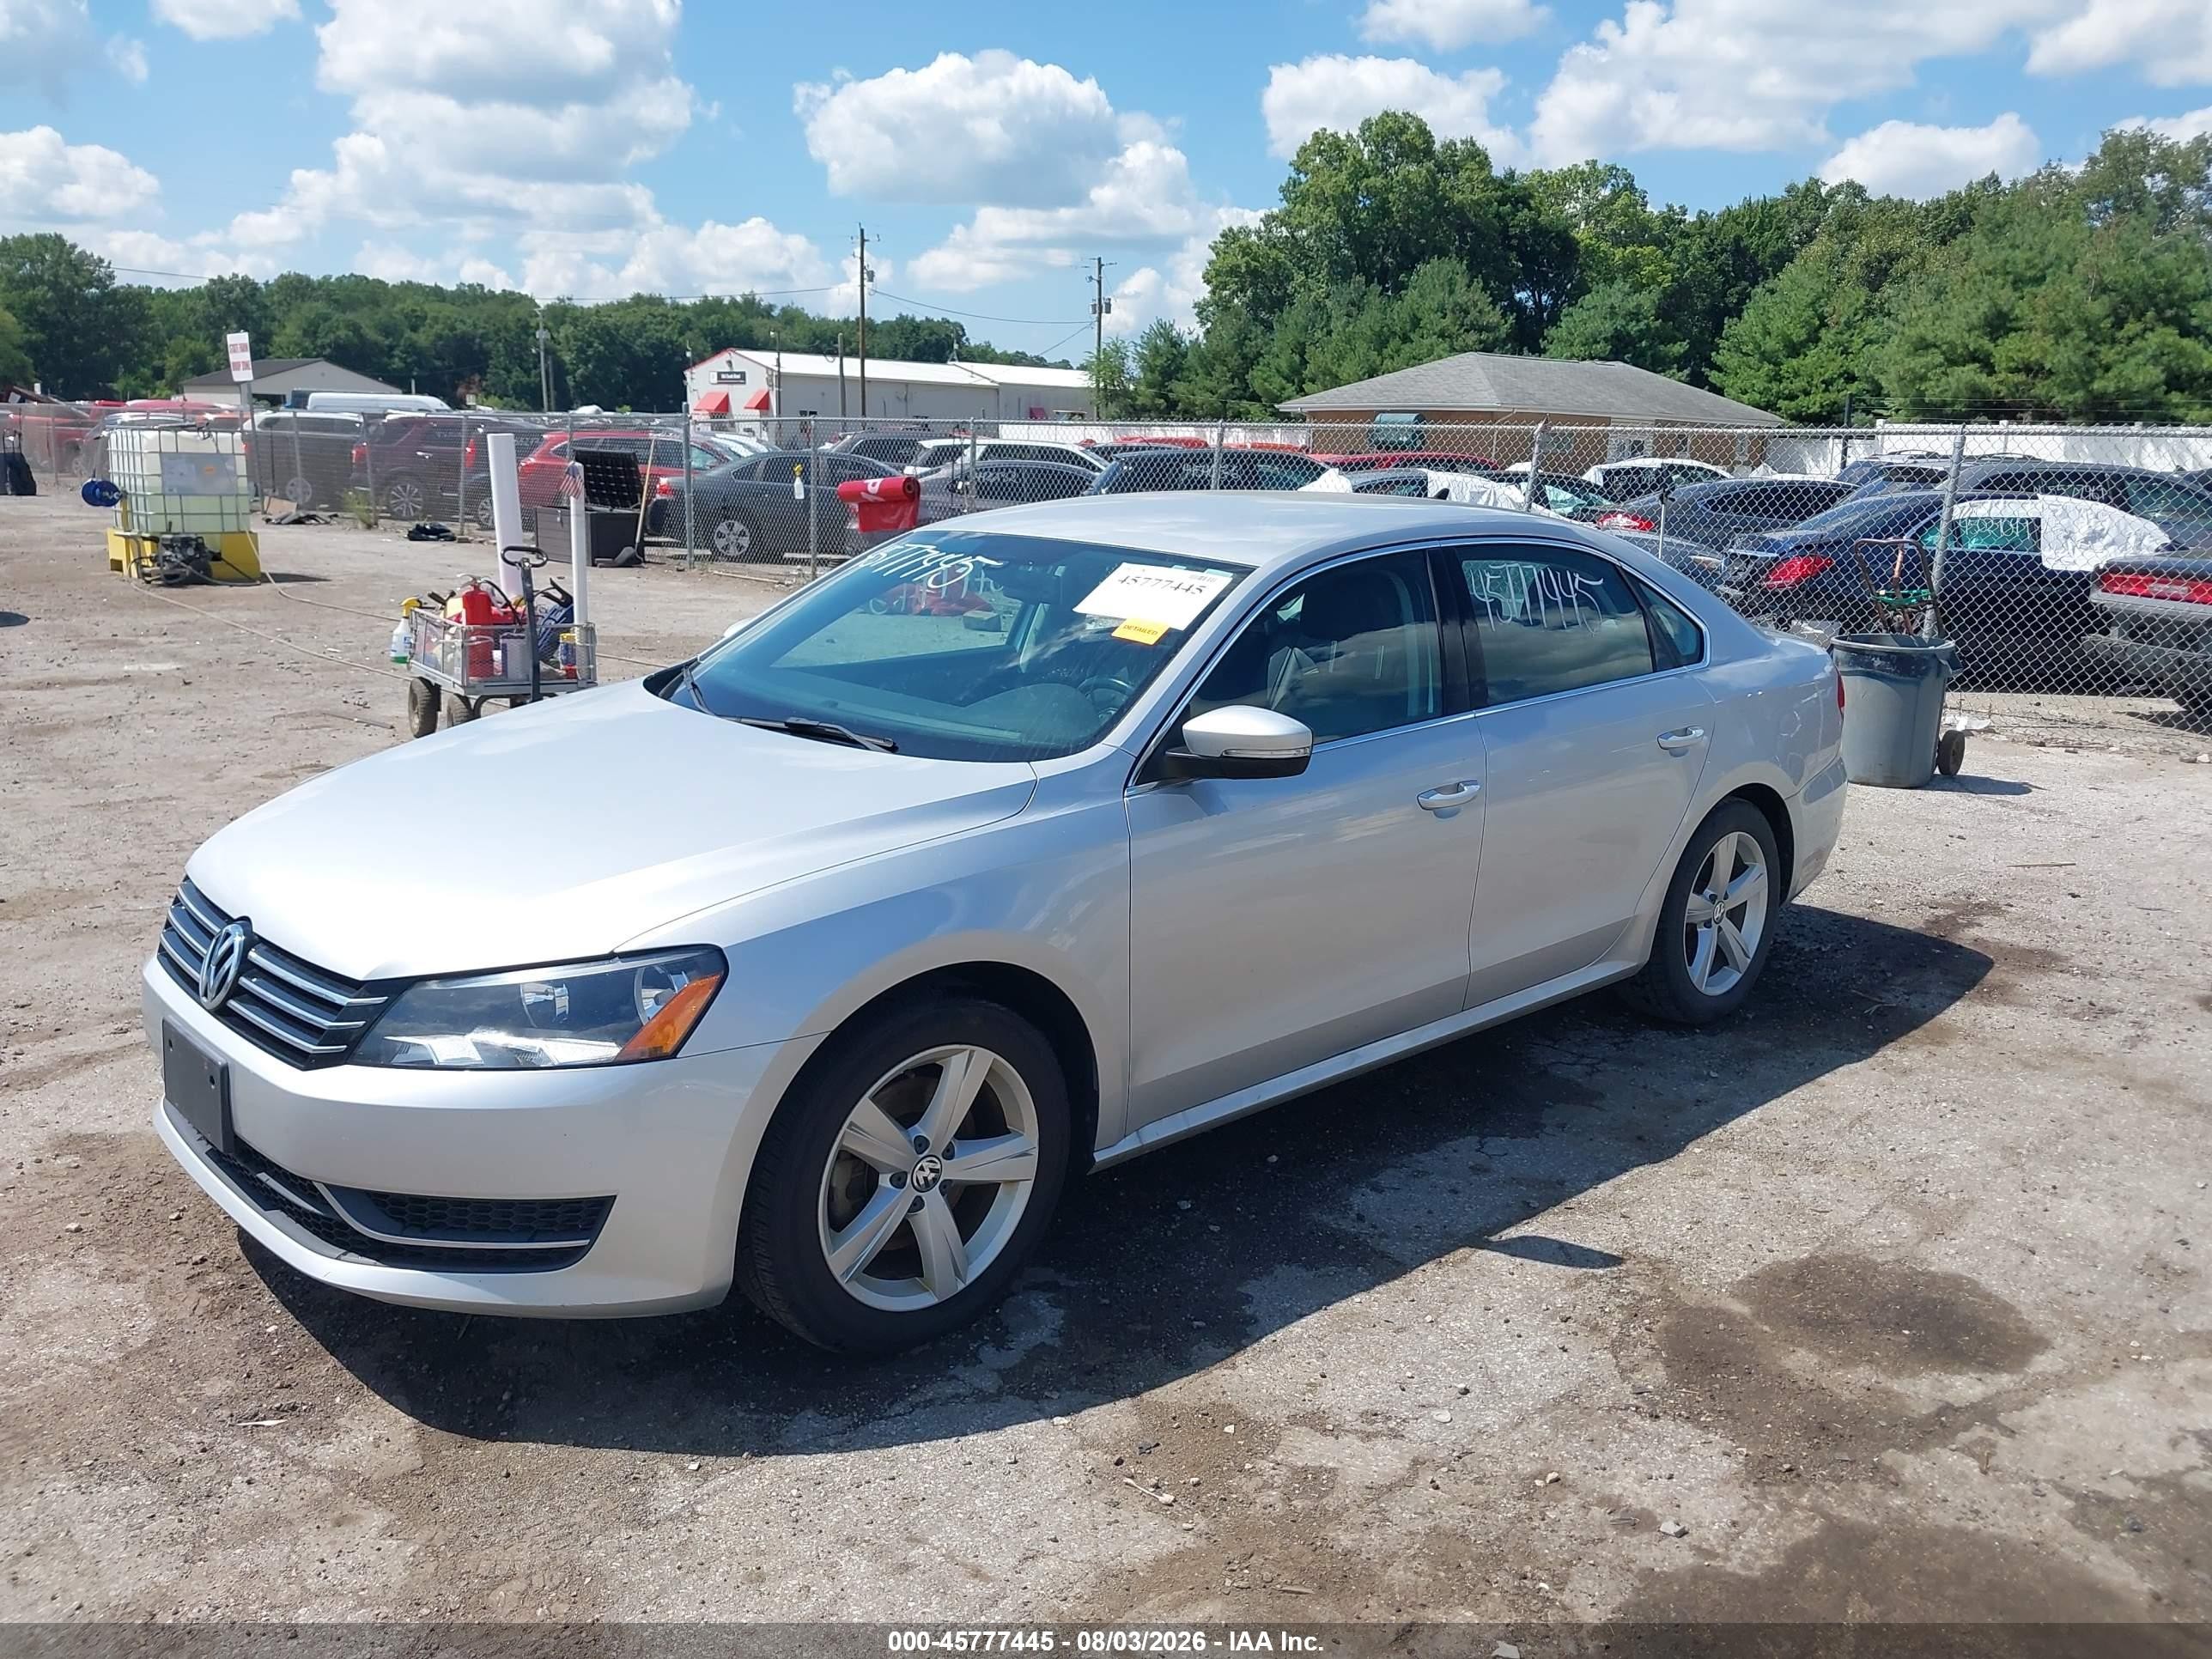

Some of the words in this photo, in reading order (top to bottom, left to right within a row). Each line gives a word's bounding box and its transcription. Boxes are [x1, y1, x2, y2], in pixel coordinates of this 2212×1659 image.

[1118, 575, 1206, 594] 45777445
[1469, 563, 1604, 636] 45777445
[1123, 624, 1158, 635] DETAILED
